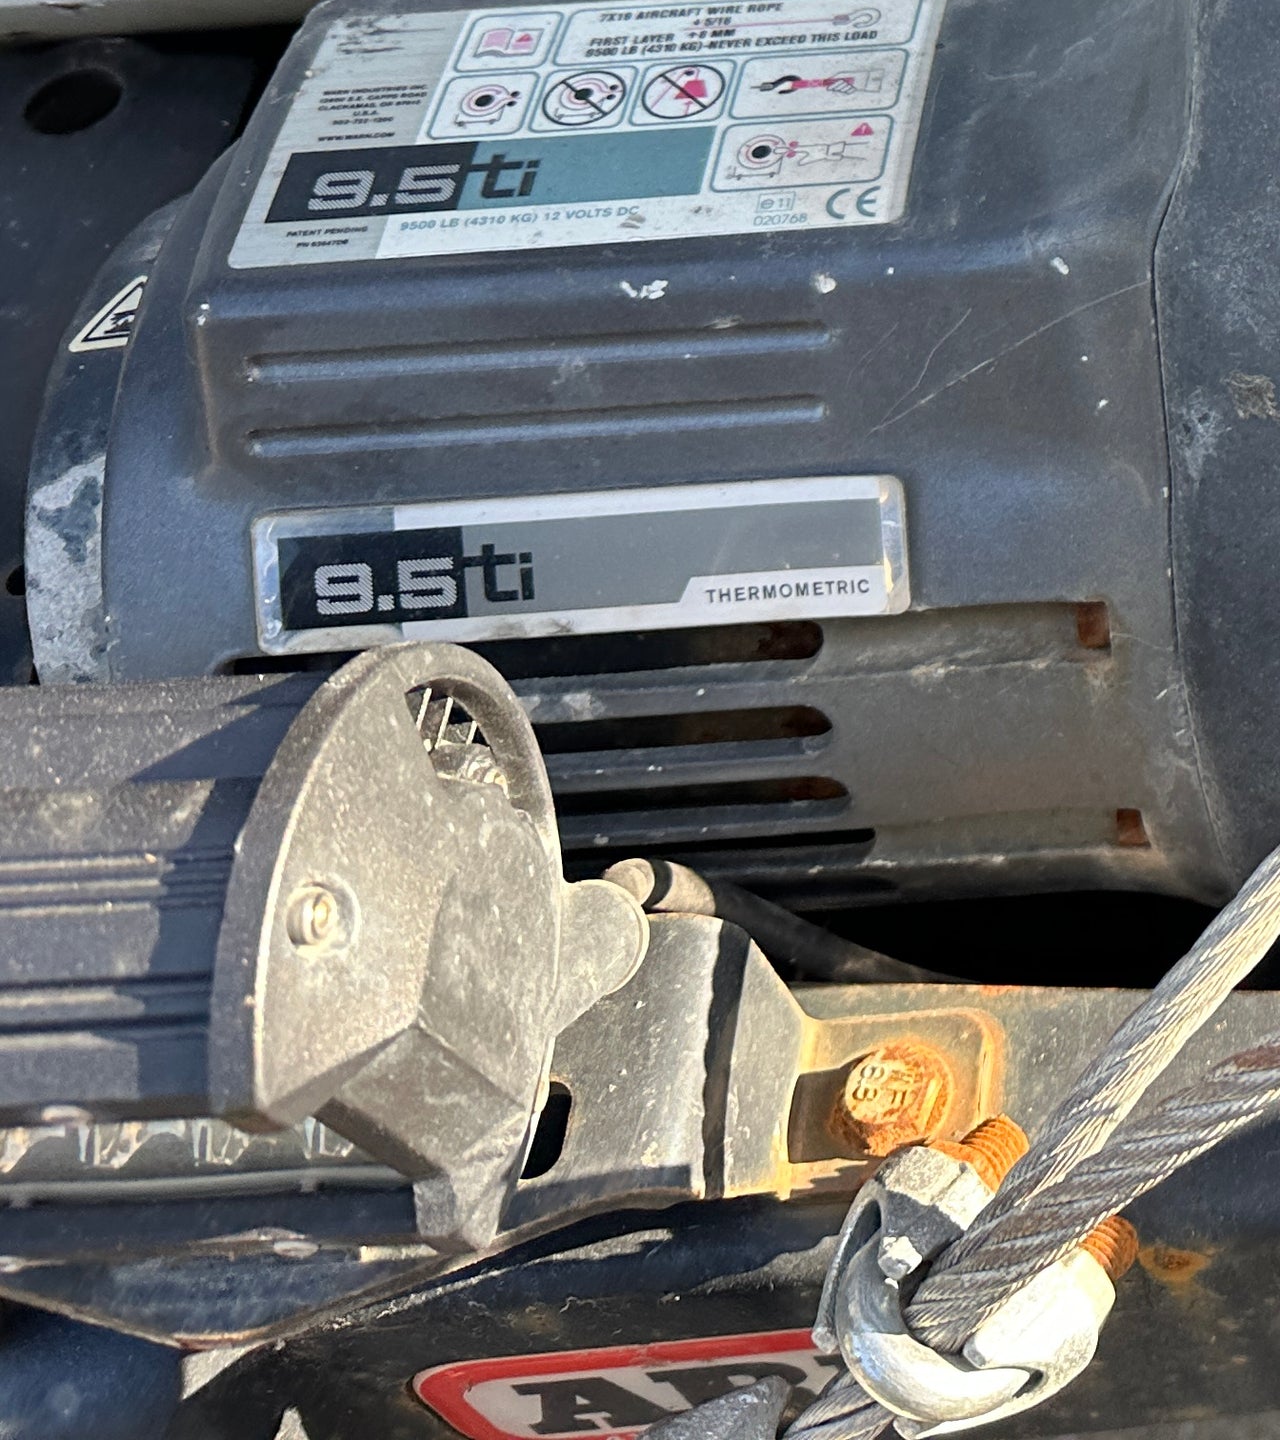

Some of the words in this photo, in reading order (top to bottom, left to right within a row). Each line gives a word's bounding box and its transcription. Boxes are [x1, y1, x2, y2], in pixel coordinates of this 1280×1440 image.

[635, 8, 703, 20] AIRCRAFT
[706, 5, 742, 16] WIRE
[747, 2, 784, 13] ROPE
[590, 36, 629, 46] FIRST
[632, 33, 675, 45] LAYER
[621, 46, 638, 55] LB
[755, 34, 807, 47] EXCEED
[811, 32, 841, 43] THIS
[844, 30, 878, 41] LOAD
[826, 185, 881, 220] CE
[400, 219, 435, 231] 9500
[440, 218, 460, 229] LB
[463, 215, 506, 228] (4310
[510, 212, 538, 224] KG)
[544, 211, 561, 222] 12
[565, 207, 612, 220] VOLTS
[616, 206, 640, 217] DC
[753, 212, 808, 226] 020768
[286, 229, 322, 237] PATENT
[324, 225, 368, 235] PENDING
[705, 576, 872, 604] THERMOMETRIC
